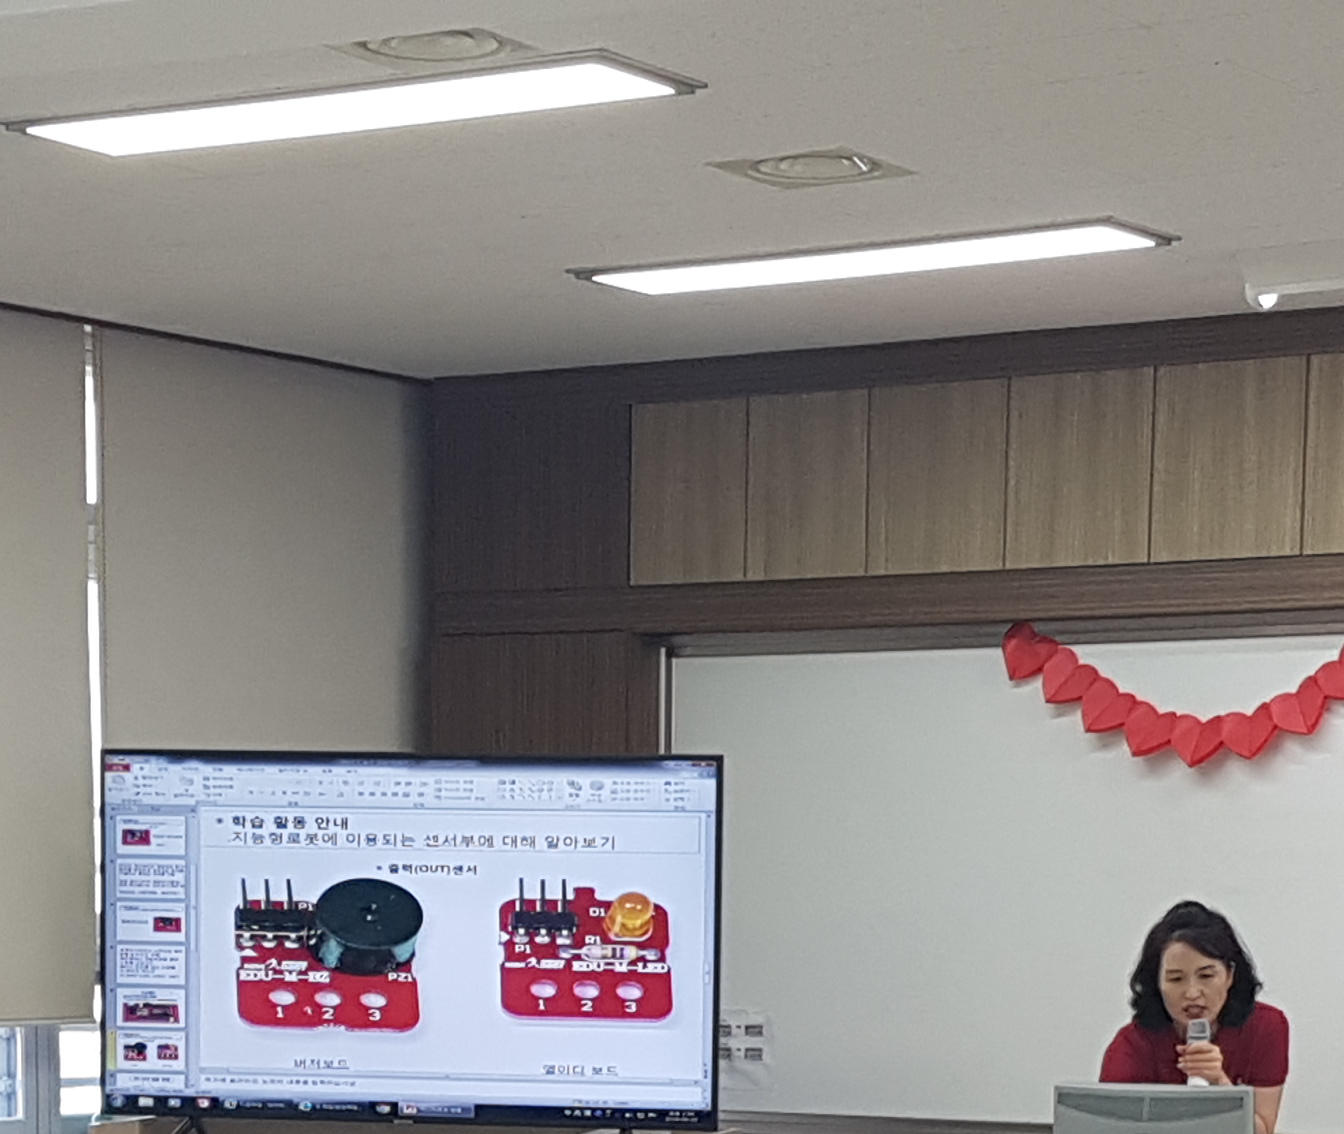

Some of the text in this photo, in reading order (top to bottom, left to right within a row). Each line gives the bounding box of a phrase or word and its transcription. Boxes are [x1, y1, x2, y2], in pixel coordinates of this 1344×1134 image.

[231, 815, 350, 831] 학습 활동 안내
[345, 832, 416, 847] 이용되는
[501, 834, 537, 849] 대해
[544, 835, 616, 851] 알아보기
[276, 1006, 382, 1021] 1 2 3
[538, 999, 637, 1013] 1 2 3
